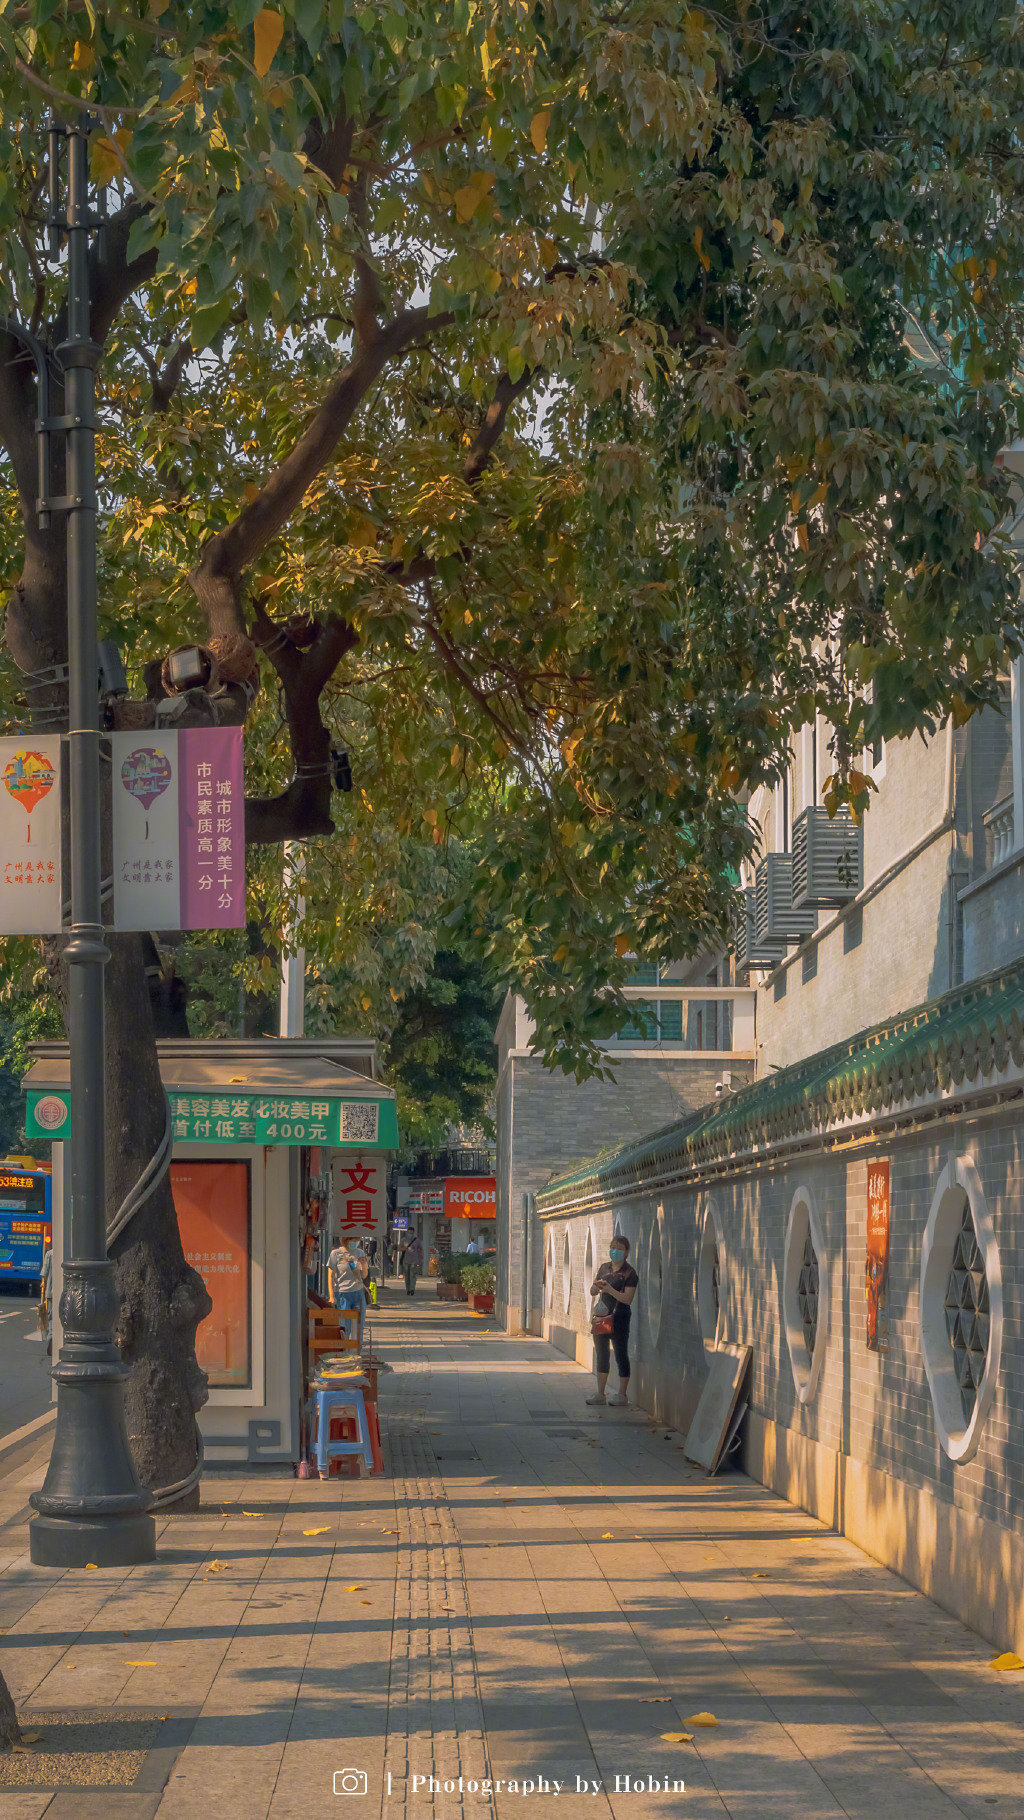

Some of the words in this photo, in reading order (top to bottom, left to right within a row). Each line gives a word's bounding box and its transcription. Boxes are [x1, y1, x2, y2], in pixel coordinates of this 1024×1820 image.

[197, 761, 214, 891] 市民素质高一分
[216, 780, 233, 909] 城市形象美十分
[4, 861, 56, 872] 广州是我家
[121, 860, 174, 871] 广州是我家
[4, 874, 56, 884] 文明靠大家
[121, 872, 174, 883] 文明靠大家
[171, 1099, 330, 1120] 美容美发化妆美甲
[340, 1163, 378, 1231] 文具
[449, 1190, 496, 1204] RICOH
